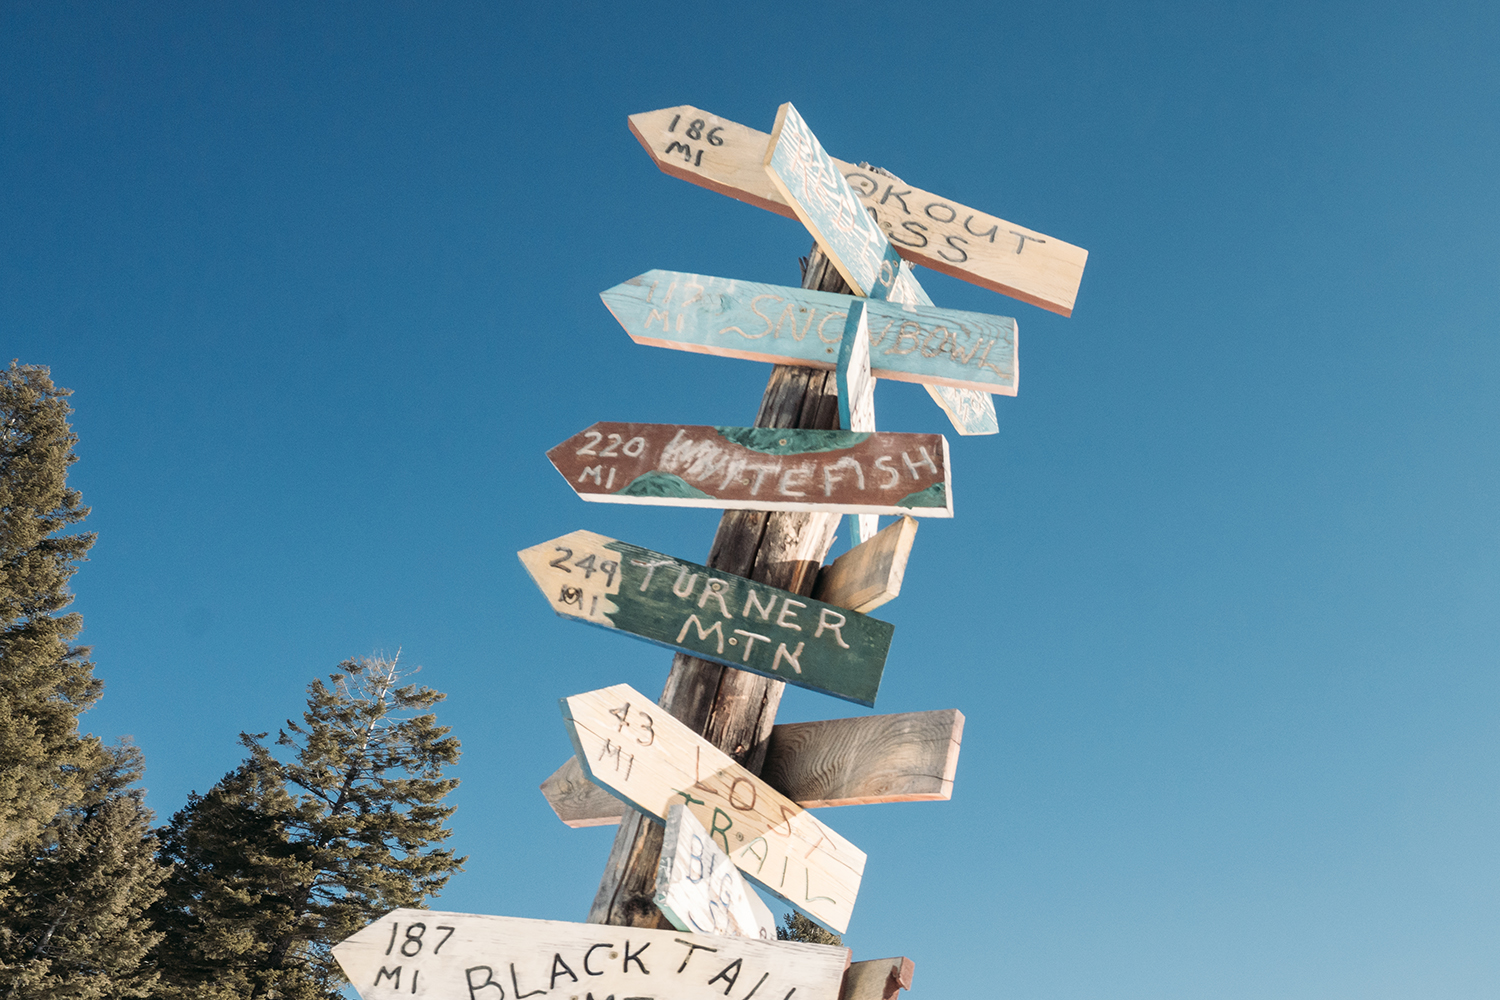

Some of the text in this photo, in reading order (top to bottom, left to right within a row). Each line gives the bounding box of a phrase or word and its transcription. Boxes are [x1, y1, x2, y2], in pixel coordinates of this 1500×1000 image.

[667, 114, 725, 147] 186
[665, 141, 705, 167] MI
[844, 172, 1047, 254] OKOUT
[644, 309, 684, 332] MI
[576, 431, 645, 458] 220
[577, 464, 617, 489] MI
[660, 429, 939, 498] WHITEFISH
[549, 546, 619, 587] 249
[558, 584, 598, 617] MI
[631, 559, 850, 650] TURNER
[608, 702, 656, 747] 43
[597, 737, 634, 781] MI
[694, 745, 837, 859] LOST
[384, 921, 455, 958] 187
[373, 966, 419, 994] MI
